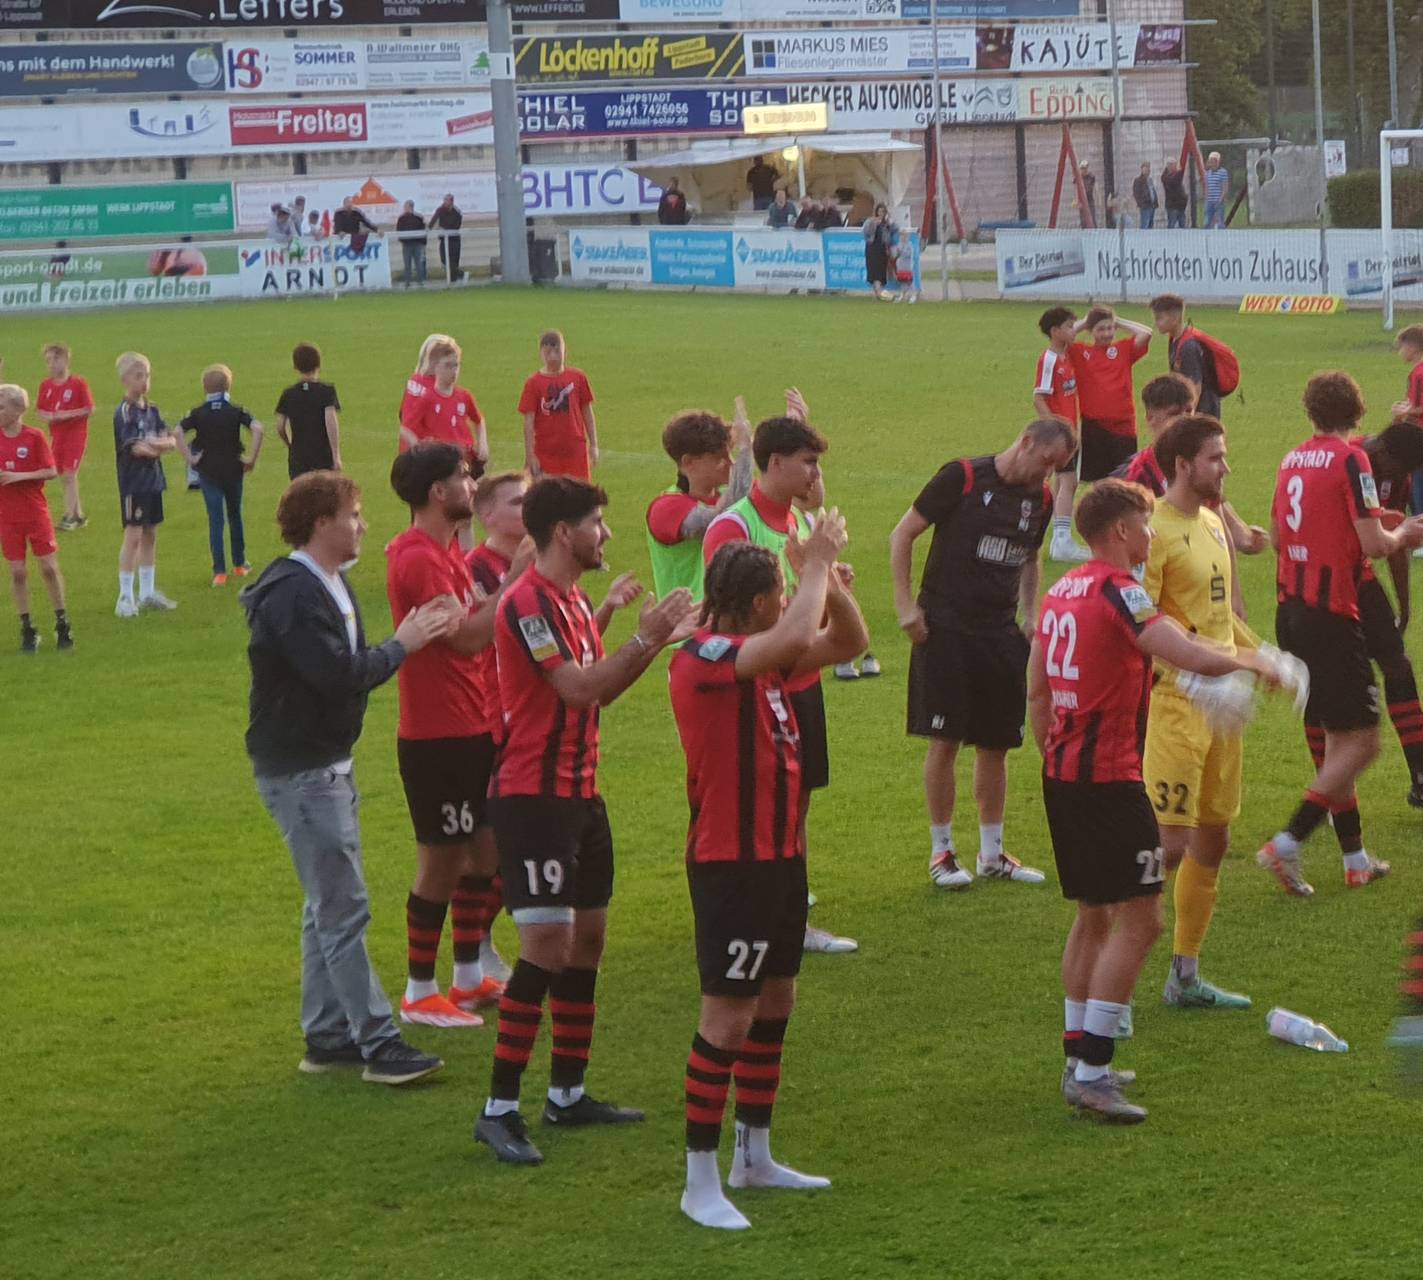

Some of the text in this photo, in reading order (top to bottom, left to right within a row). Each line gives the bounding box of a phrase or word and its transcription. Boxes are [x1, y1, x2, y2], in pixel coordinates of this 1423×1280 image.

[294, 51, 356, 65] SOMMER
[538, 37, 660, 73] Löckenhoff
[776, 37, 889, 54] MARKUS MIES
[18, 58, 46, 71] mit
[50, 56, 87, 70] dem
[90, 54, 176, 69] Handwerk!
[776, 55, 888, 69] Fliesenlegermeister
[620, 92, 672, 104] LIPPSTADT
[706, 90, 781, 108] THIEL
[857, 82, 958, 111] AUTOMOBLE
[276, 108, 364, 136] Freitag
[604, 104, 638, 119] 02941
[261, 265, 369, 293] ARNDT
[1097, 250, 1201, 285] Nachrichten
[1209, 256, 1250, 282] von
[134, 273, 212, 299] erleben
[1243, 296, 1335, 312] WEST LOTTO
[1286, 474, 1304, 533] 3
[1041, 608, 1080, 680] 22
[1155, 780, 1191, 816] 32
[441, 802, 474, 836] 36
[523, 858, 565, 896] 19
[725, 938, 770, 982] 27
